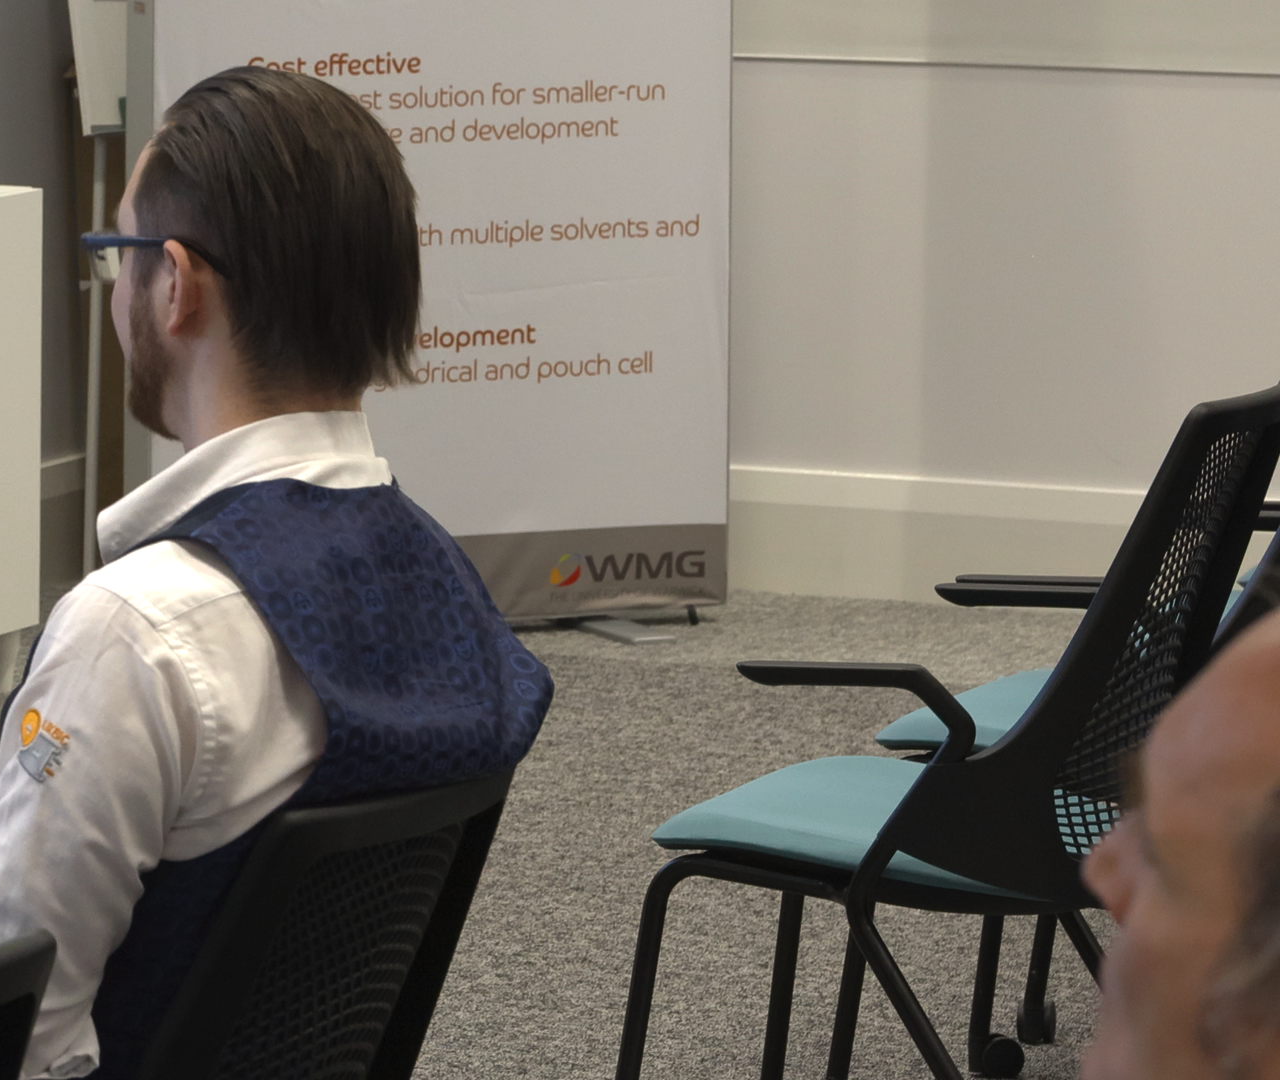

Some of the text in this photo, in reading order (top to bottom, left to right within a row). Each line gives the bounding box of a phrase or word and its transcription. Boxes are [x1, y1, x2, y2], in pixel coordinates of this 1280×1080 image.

[314, 53, 422, 77] effective
[389, 84, 485, 110] solution
[492, 82, 526, 106] for
[532, 79, 666, 105] smaller-run
[409, 117, 455, 144] and
[462, 116, 619, 145] development
[450, 219, 544, 248] multiple
[550, 216, 649, 241] solvents
[655, 213, 700, 238] and
[416, 324, 537, 353] elopment
[485, 356, 531, 382] and
[537, 353, 611, 384] pouch
[617, 350, 654, 375] cell
[584, 550, 706, 583] WMG
